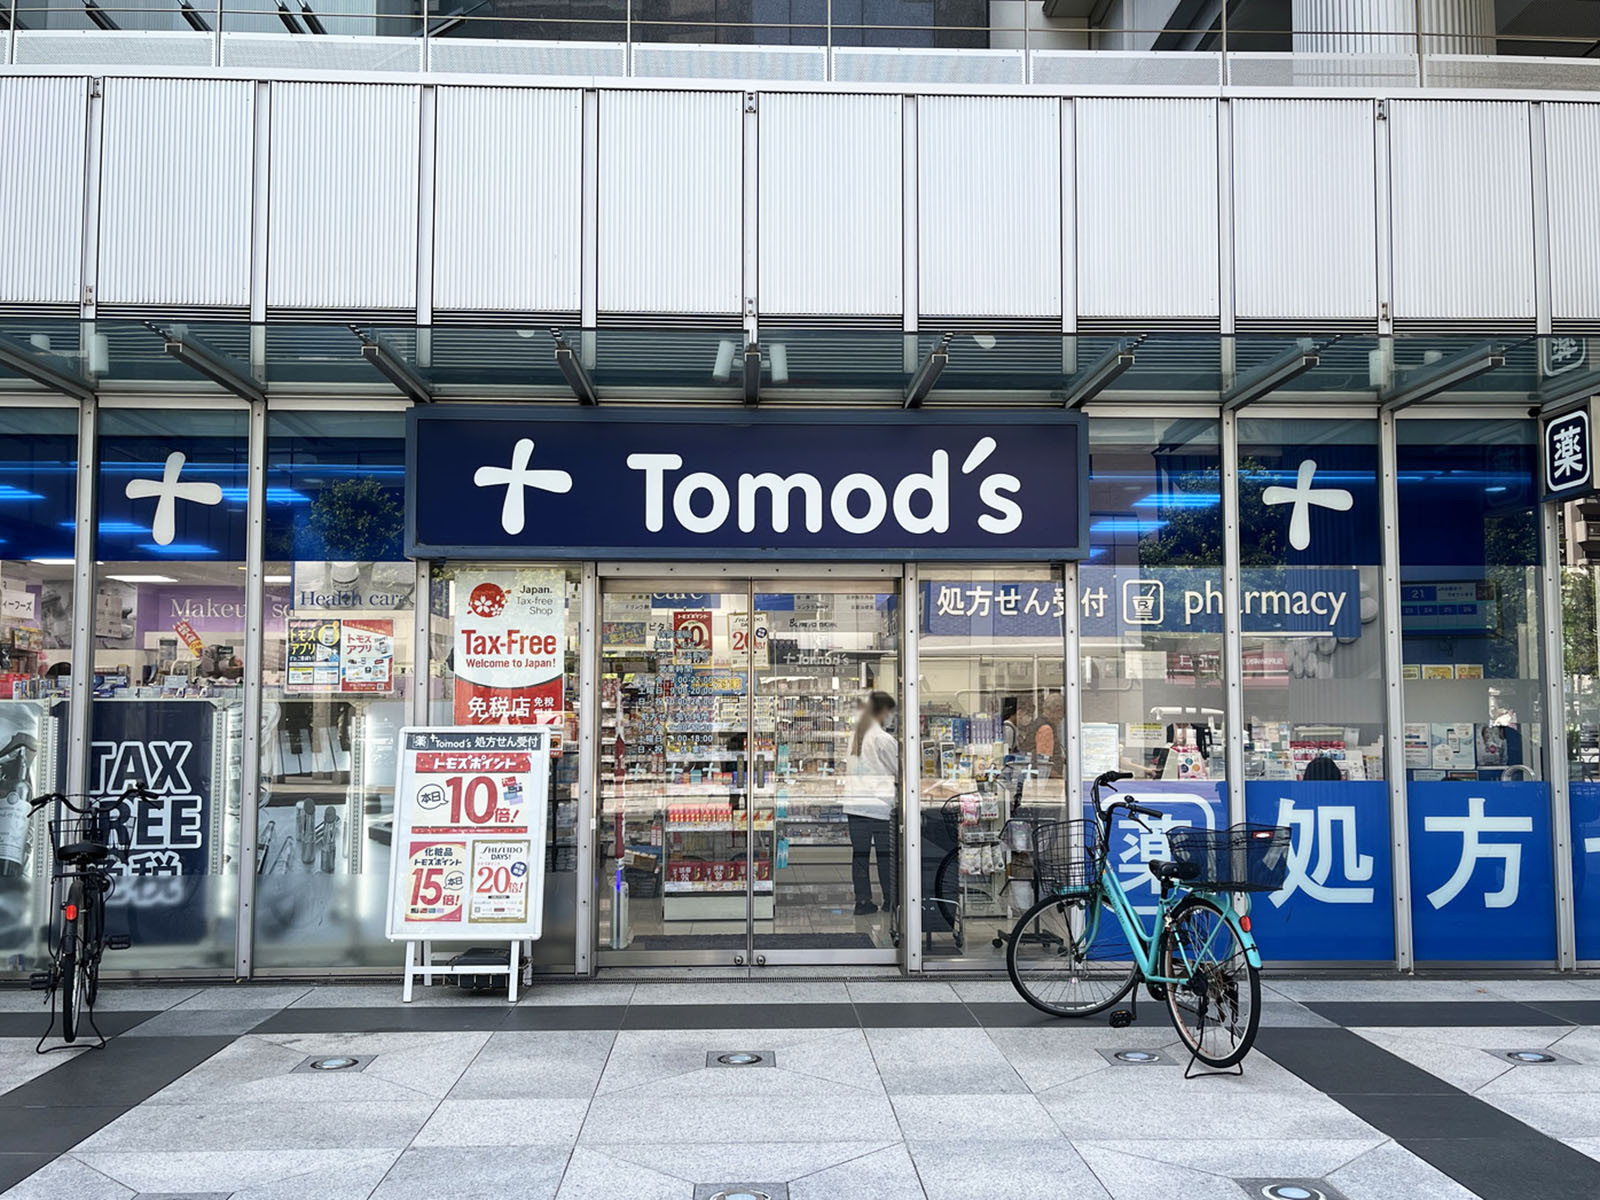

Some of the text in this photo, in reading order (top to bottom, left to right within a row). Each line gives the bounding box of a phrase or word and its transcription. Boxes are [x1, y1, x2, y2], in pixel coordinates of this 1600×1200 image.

[1553, 425, 1583, 478] 薬
[627, 437, 1023, 534] Tomod's
[520, 585, 553, 595] Japan.
[300, 591, 361, 606] Health
[516, 596, 553, 605] Tax-free
[1184, 580, 1347, 625] phrmacy
[170, 599, 246, 618] Makeu
[529, 606, 553, 616] Shop
[290, 643, 317, 655] アプリ
[346, 644, 372, 655] アプリ
[461, 629, 557, 655] Tax-Free
[466, 658, 556, 670] Welcome to Japan!
[467, 696, 531, 722] 免税店
[436, 738, 472, 749] Tomod's
[474, 736, 539, 749] 処方せん受付
[433, 755, 517, 770] トモズポイント
[420, 790, 442, 804] 本日
[445, 775, 499, 825] 10
[89, 795, 202, 850] REE
[424, 847, 454, 857] 化粧品
[490, 853, 512, 861] DAYS!
[410, 868, 443, 906] 15
[476, 866, 511, 894] 20
